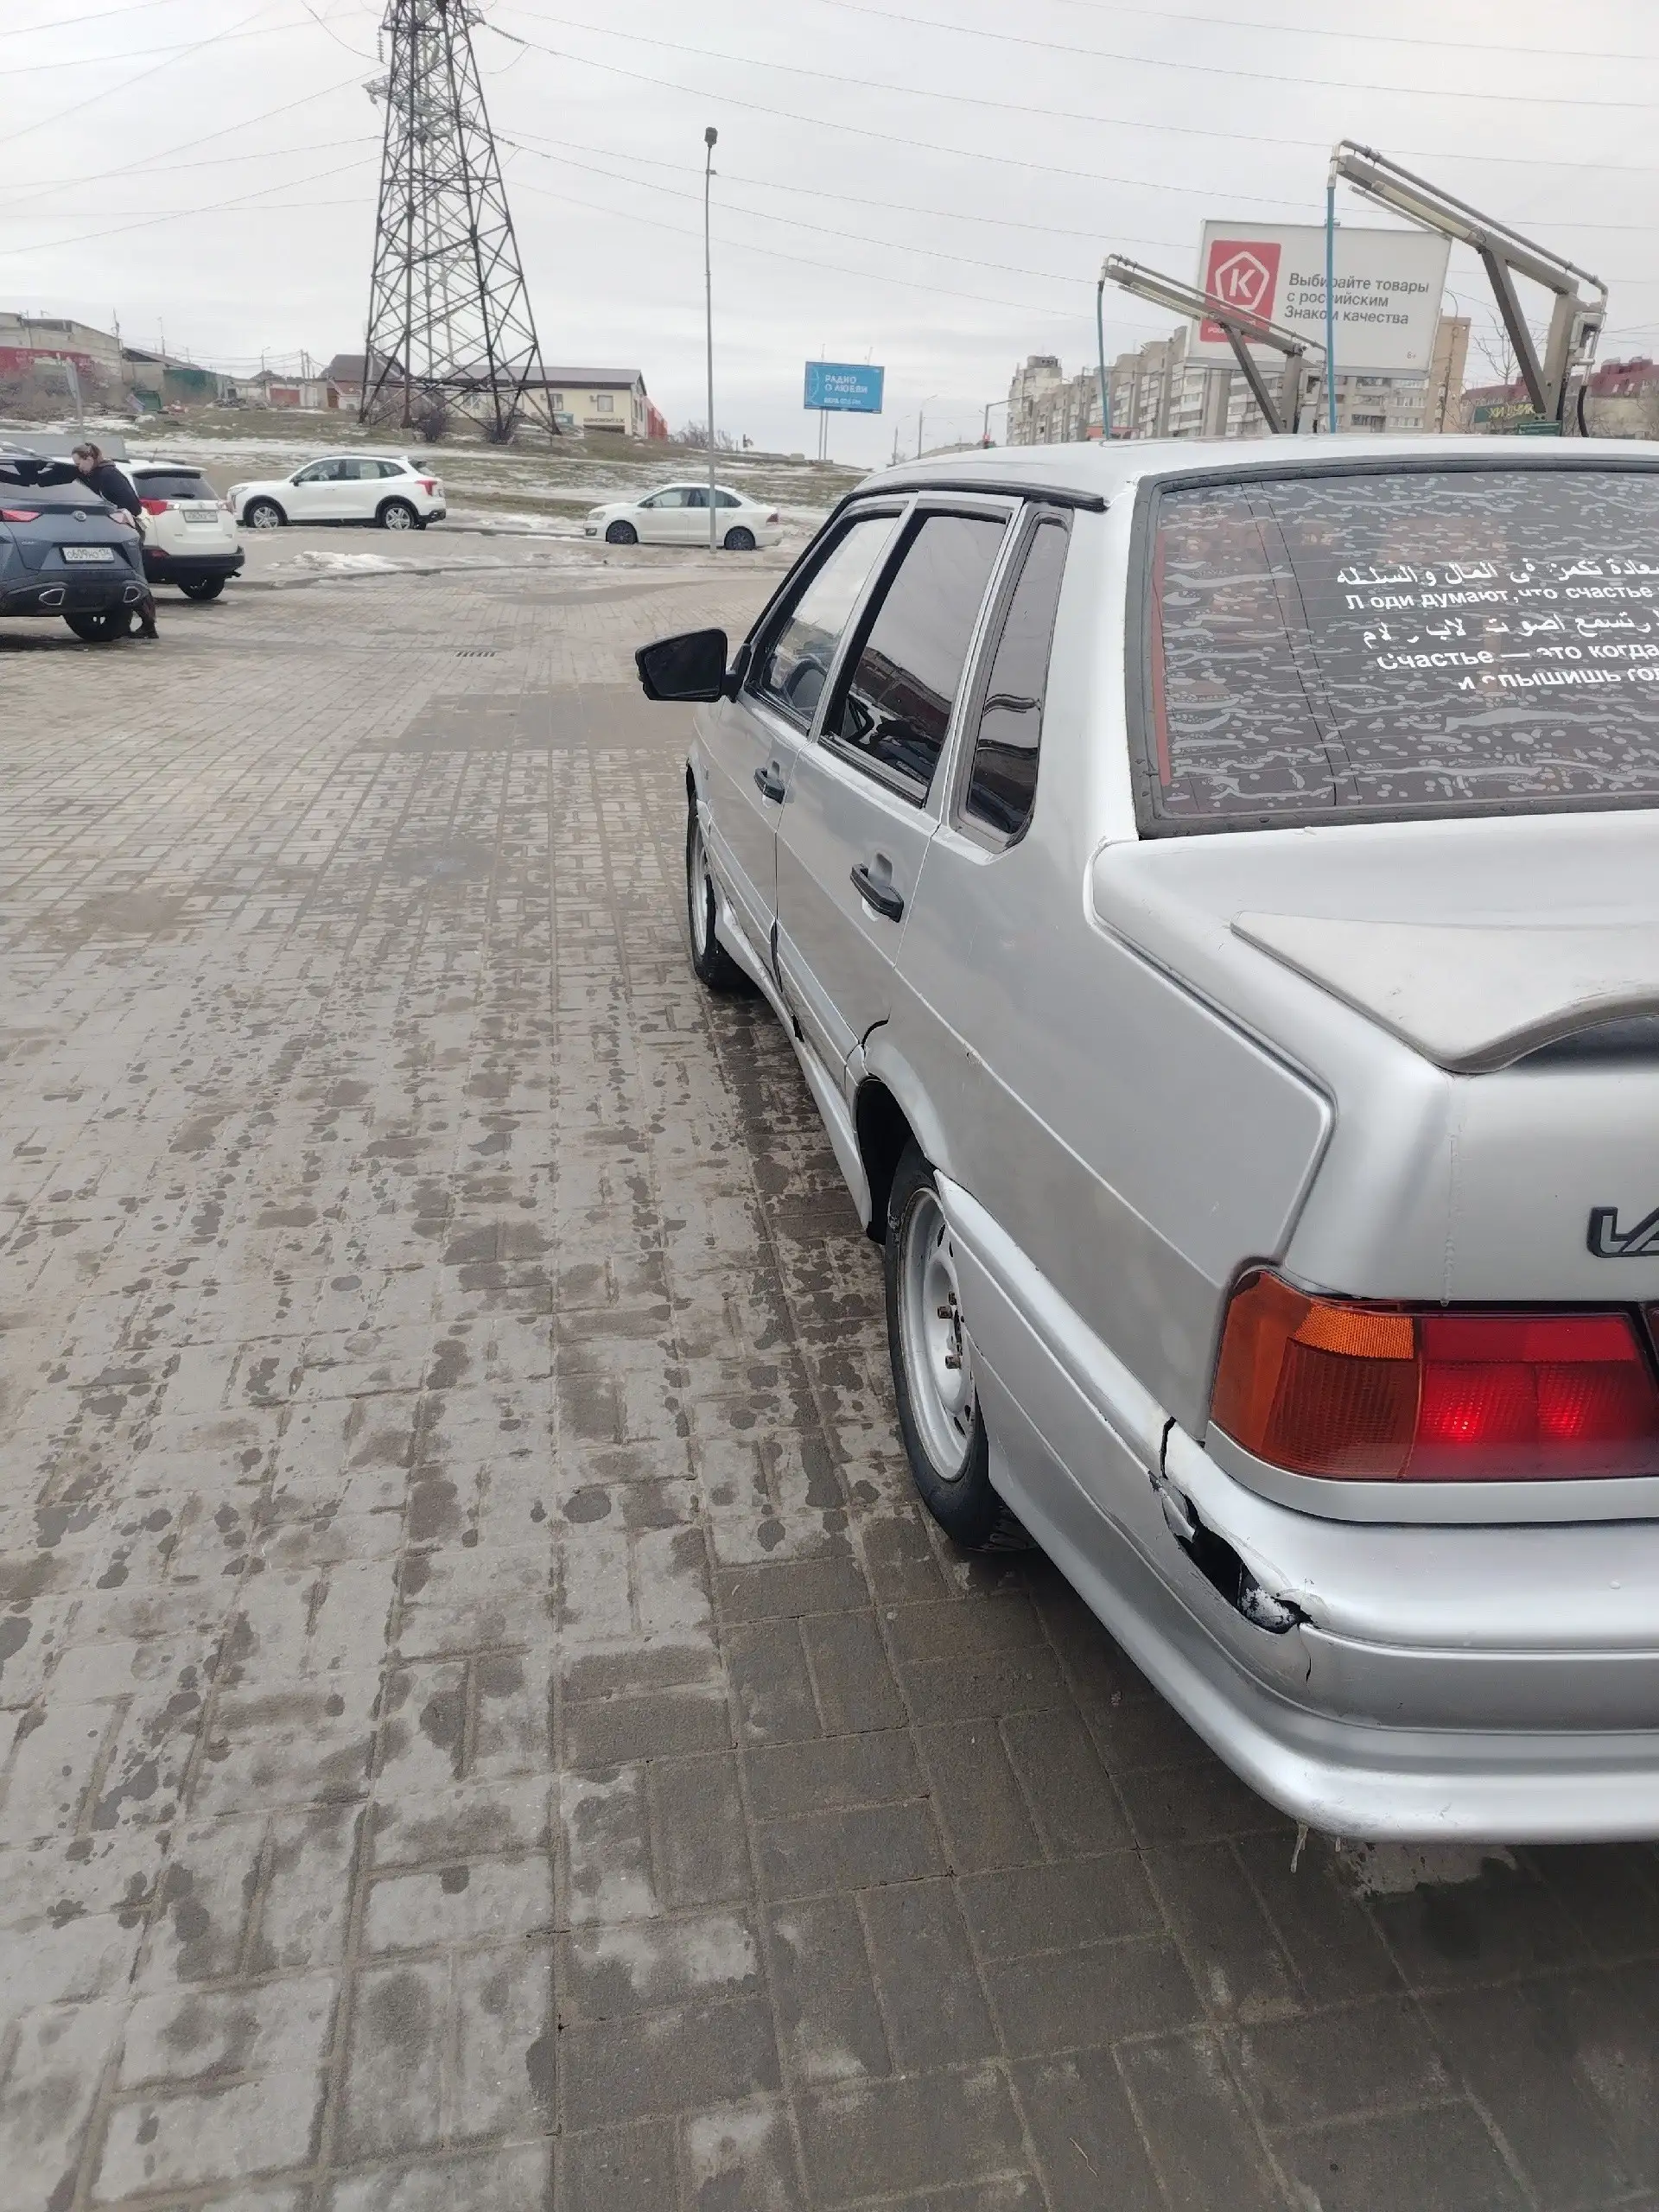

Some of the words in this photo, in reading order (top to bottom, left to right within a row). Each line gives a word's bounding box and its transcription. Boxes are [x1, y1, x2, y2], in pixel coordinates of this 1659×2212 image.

[1376, 279, 1429, 294] товары
[1287, 292, 1295, 302] с
[1299, 291, 1389, 308] росийским
[1343, 310, 1409, 325] качества
[1565, 587, 1654, 600] счастье
[1376, 651, 1495, 671] Счастье
[1587, 644, 1659, 660] когда
